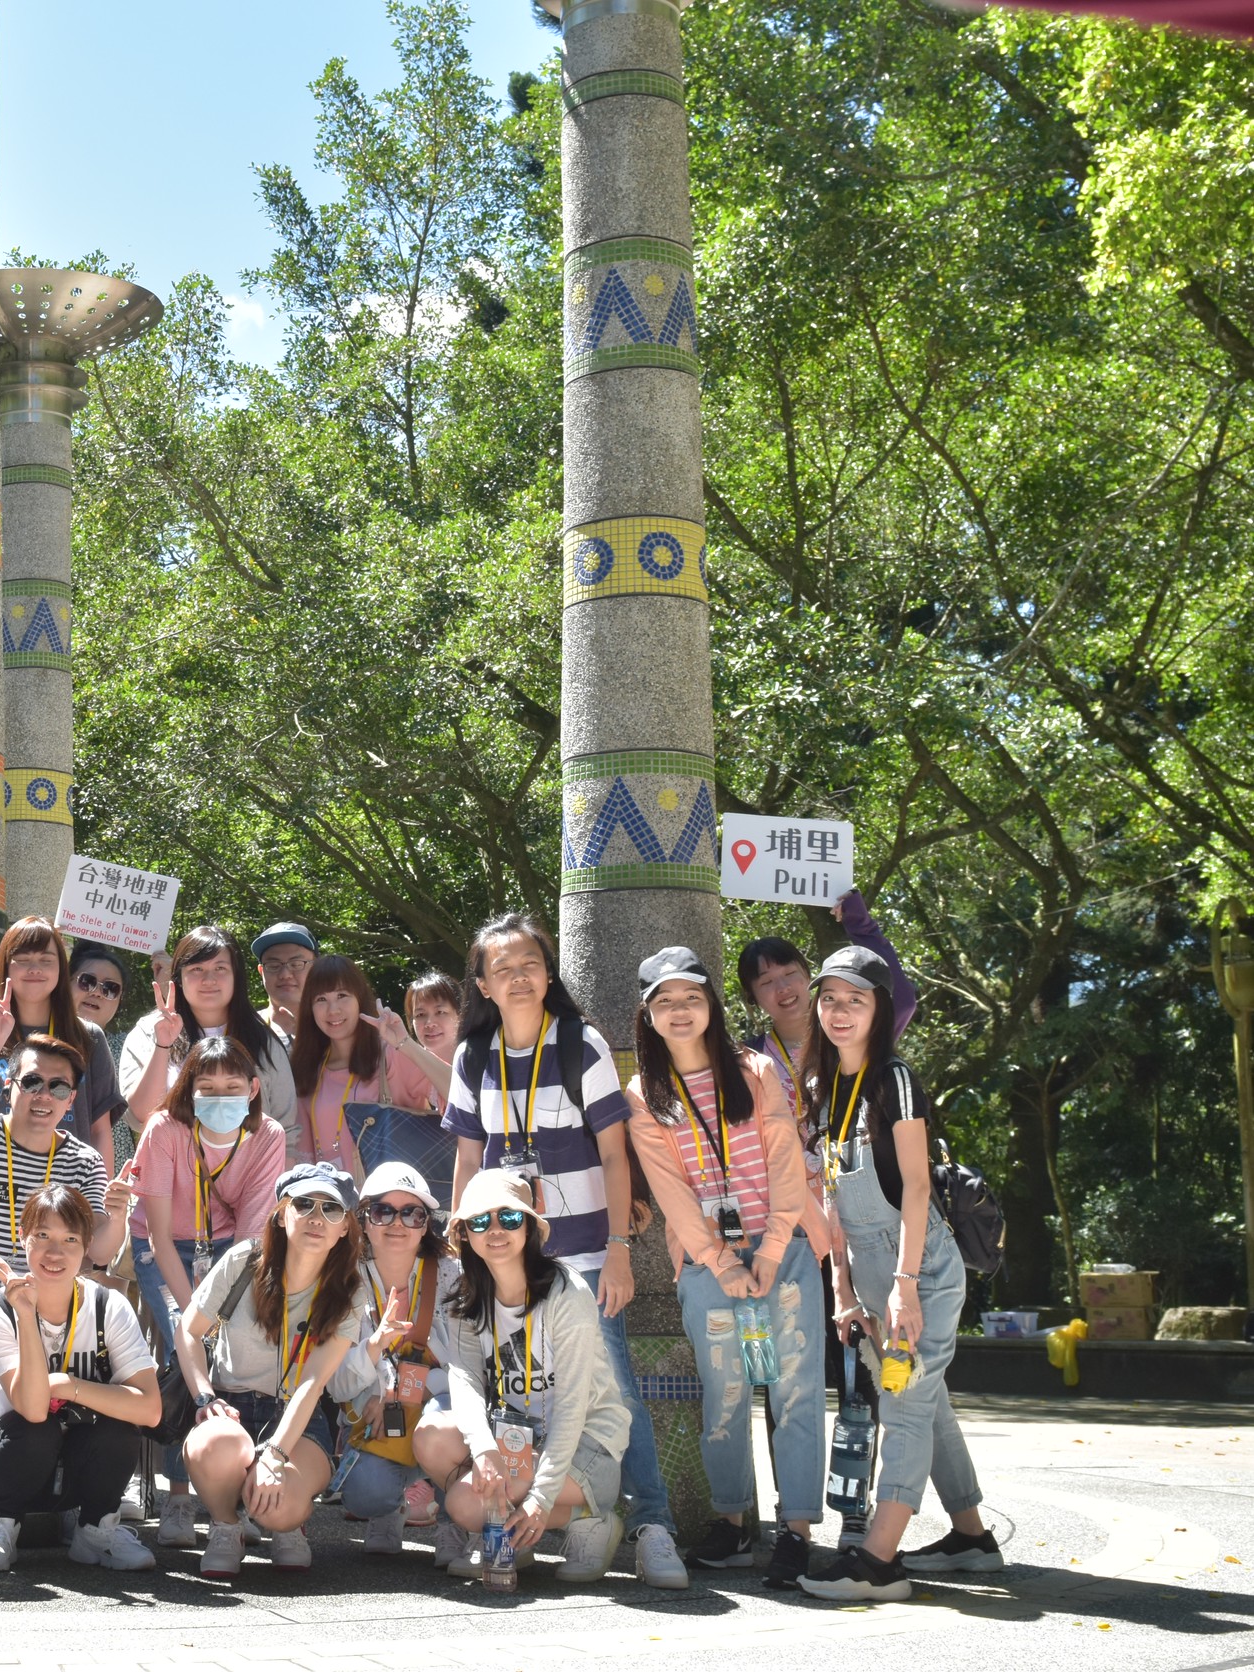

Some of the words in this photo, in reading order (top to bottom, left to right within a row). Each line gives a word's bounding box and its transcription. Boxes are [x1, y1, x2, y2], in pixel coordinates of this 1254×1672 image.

[764, 828, 842, 864] 埔里
[78, 862, 168, 901] 台灣地理
[774, 869, 829, 898] Puli
[85, 888, 152, 921] 中心碑
[62, 909, 76, 921] The
[80, 914, 103, 927] Stele
[106, 920, 117, 930] of
[121, 924, 158, 940] Taiwan's
[66, 923, 120, 943] Geographical
[124, 936, 152, 950] Center
